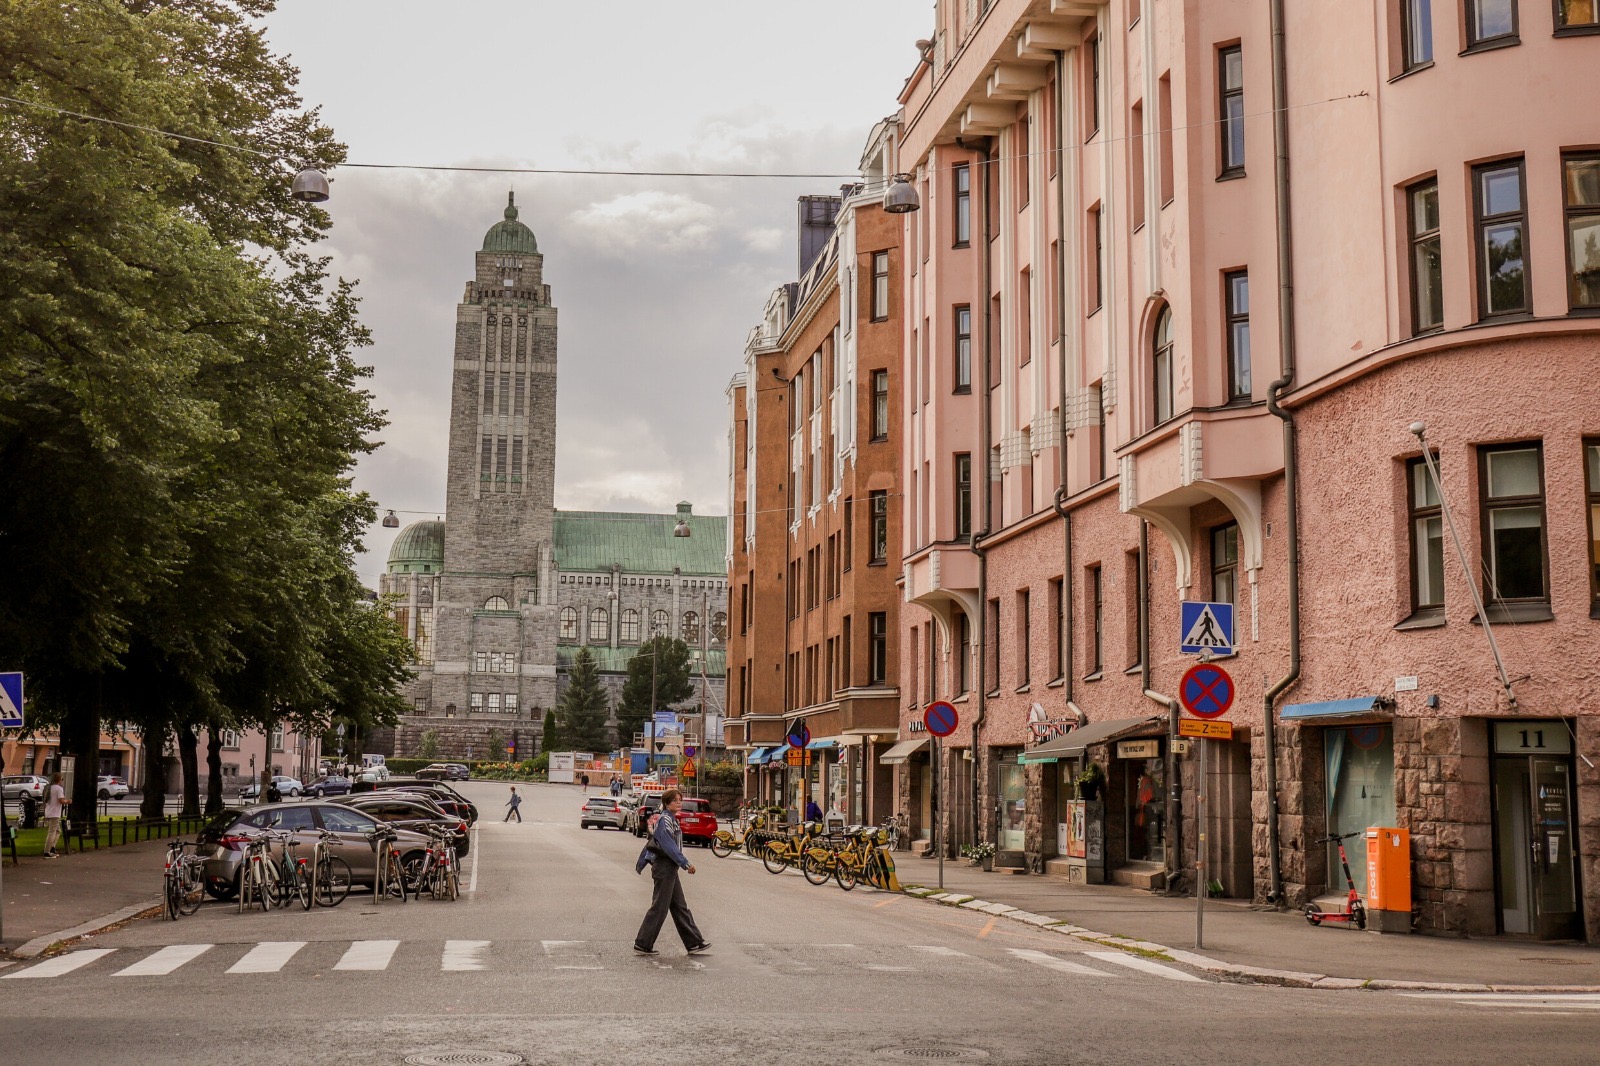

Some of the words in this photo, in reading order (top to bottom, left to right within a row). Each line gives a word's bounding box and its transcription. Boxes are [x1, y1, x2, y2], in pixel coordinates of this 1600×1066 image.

[1202, 724, 1208, 734] Z
[1519, 729, 1546, 748] 11
[1368, 861, 1378, 900] posti
